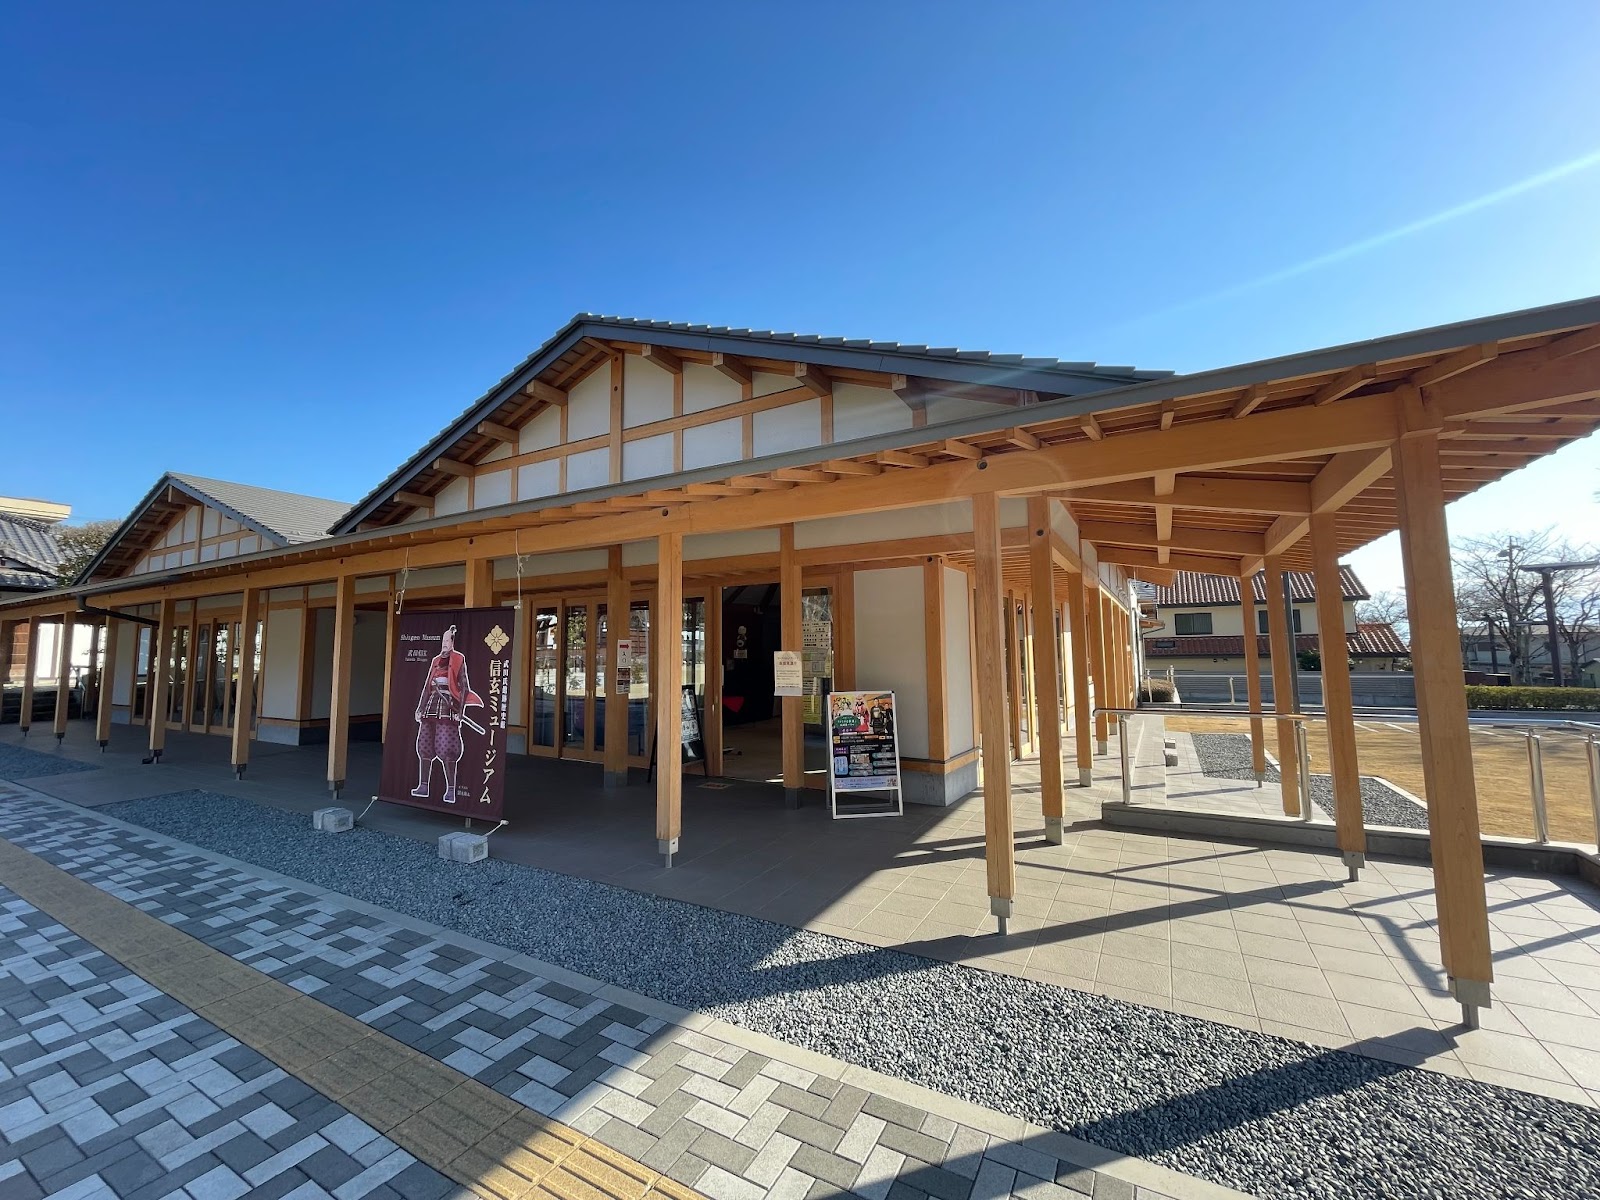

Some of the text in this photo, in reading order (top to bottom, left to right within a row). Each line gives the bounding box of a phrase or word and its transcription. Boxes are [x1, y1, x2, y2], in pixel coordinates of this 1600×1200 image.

[480, 659, 502, 804] 信玄ミュージアム
